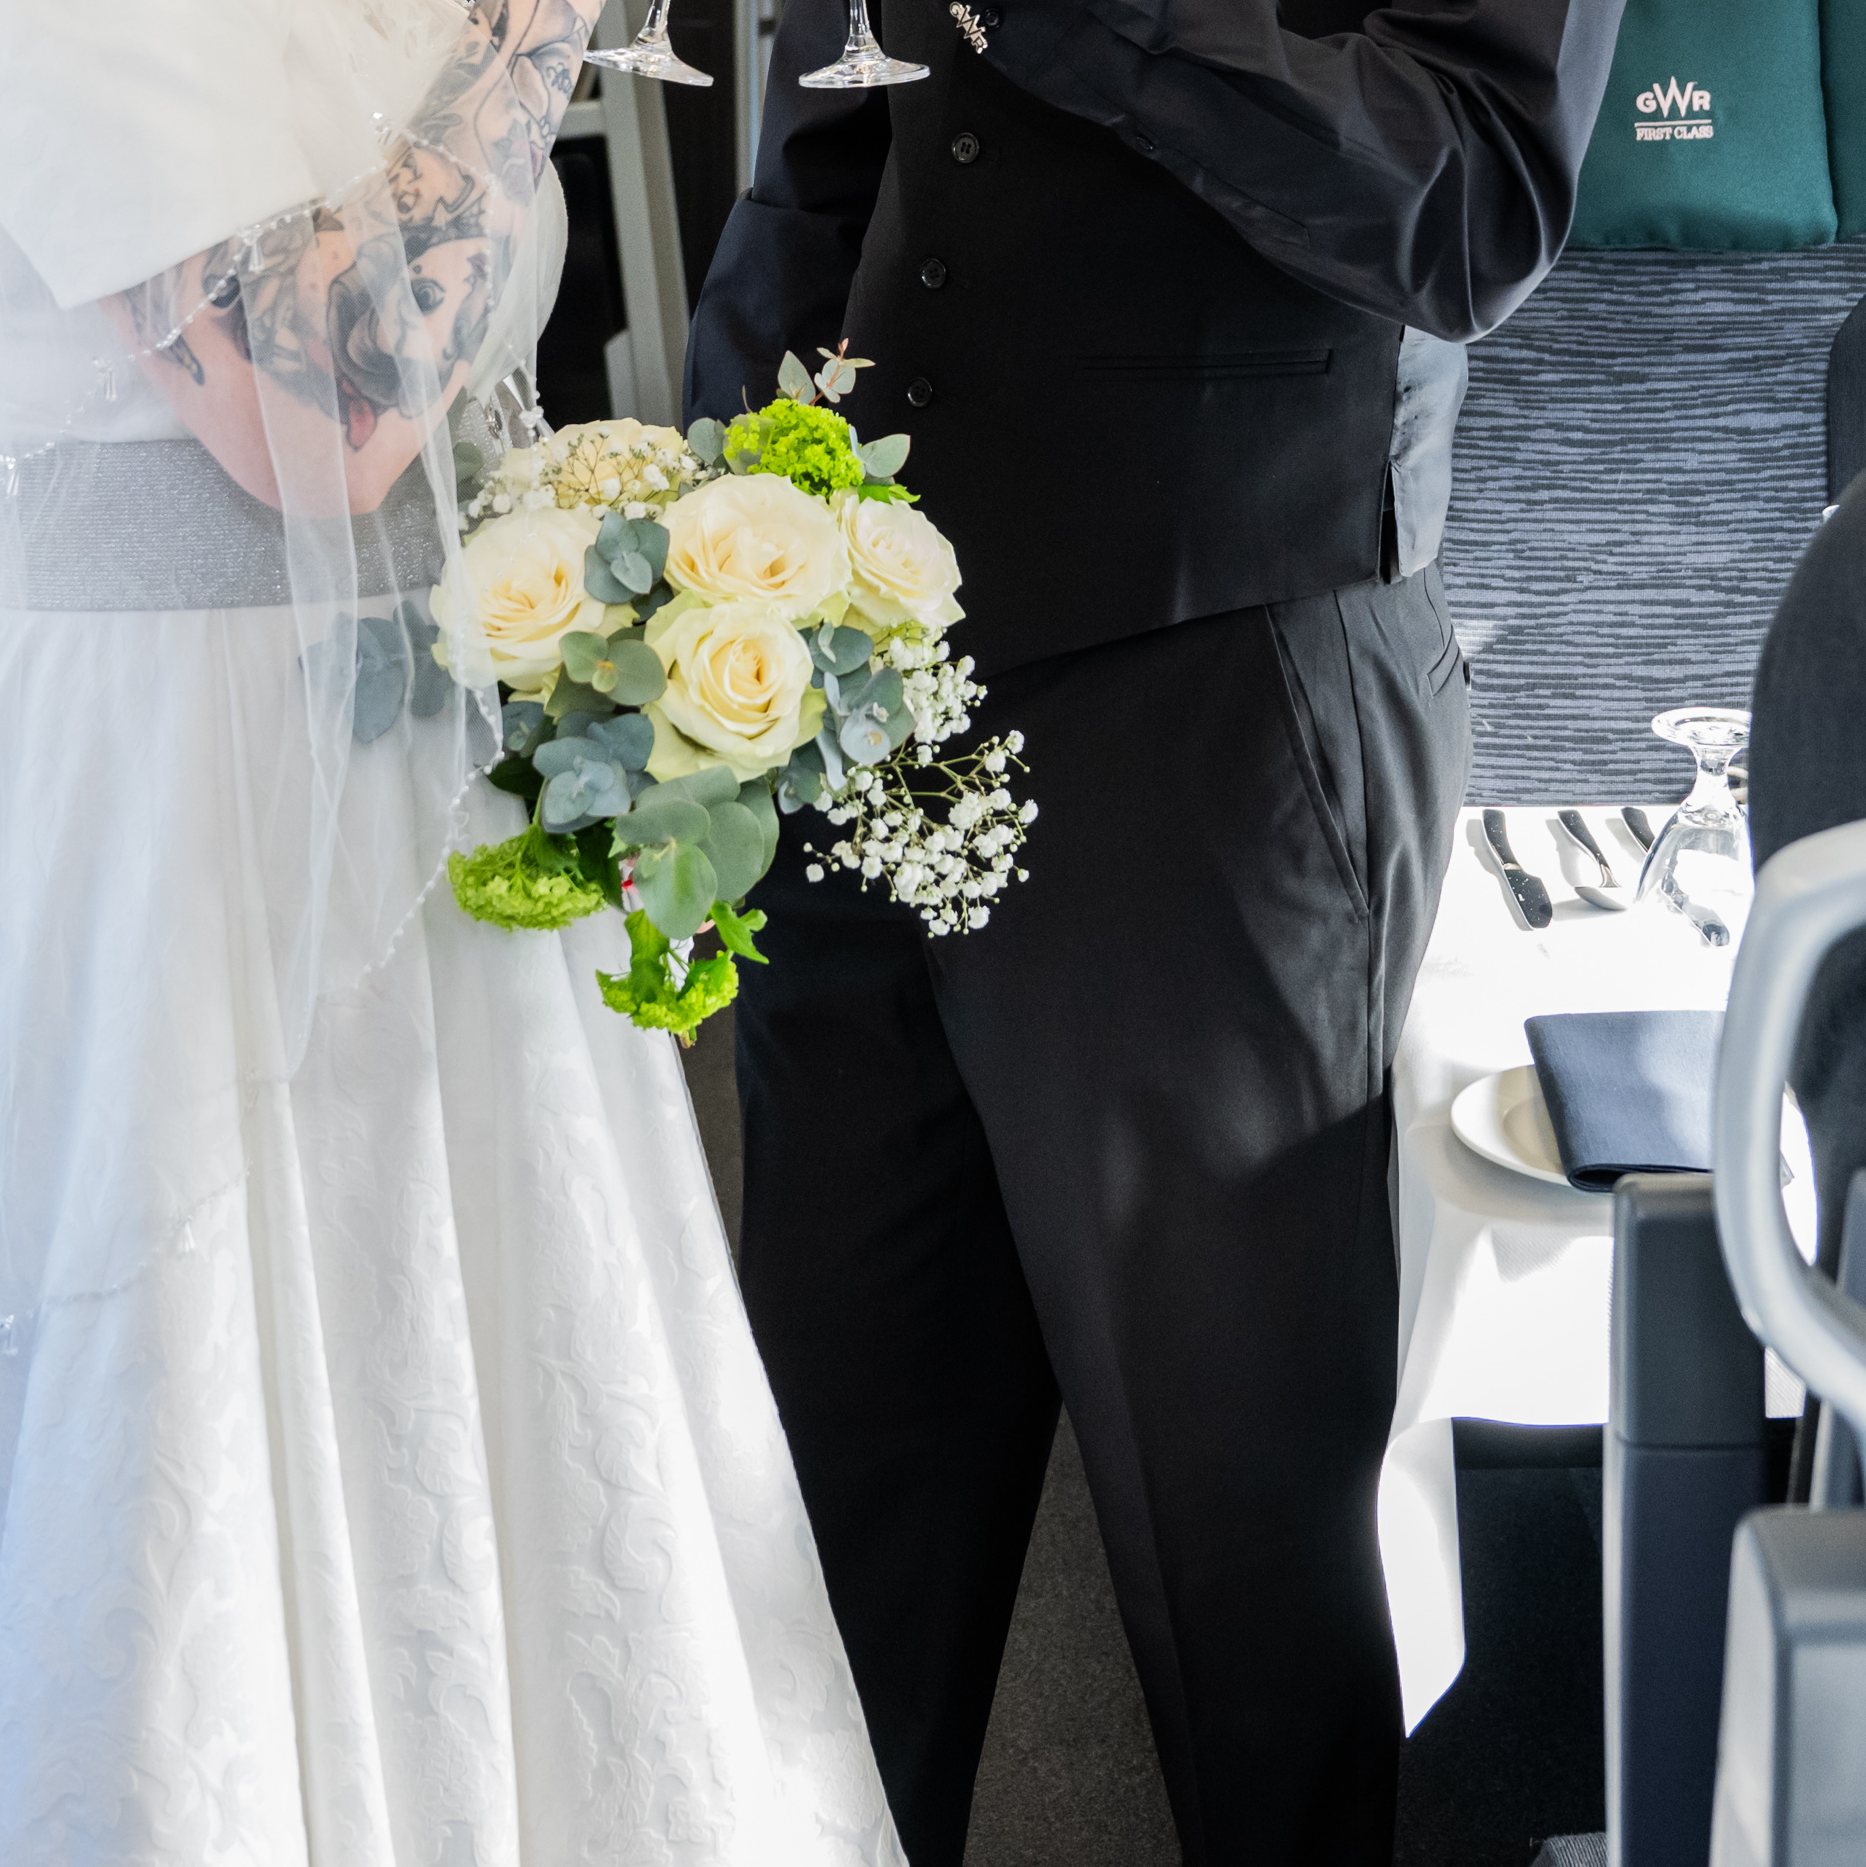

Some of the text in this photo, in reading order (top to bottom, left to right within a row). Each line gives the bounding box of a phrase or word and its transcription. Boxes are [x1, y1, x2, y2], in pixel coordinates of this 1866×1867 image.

[949, 1, 988, 54] GWR
[1635, 75, 1712, 118] GWR
[1635, 125, 1714, 141] FIRST CLASS
